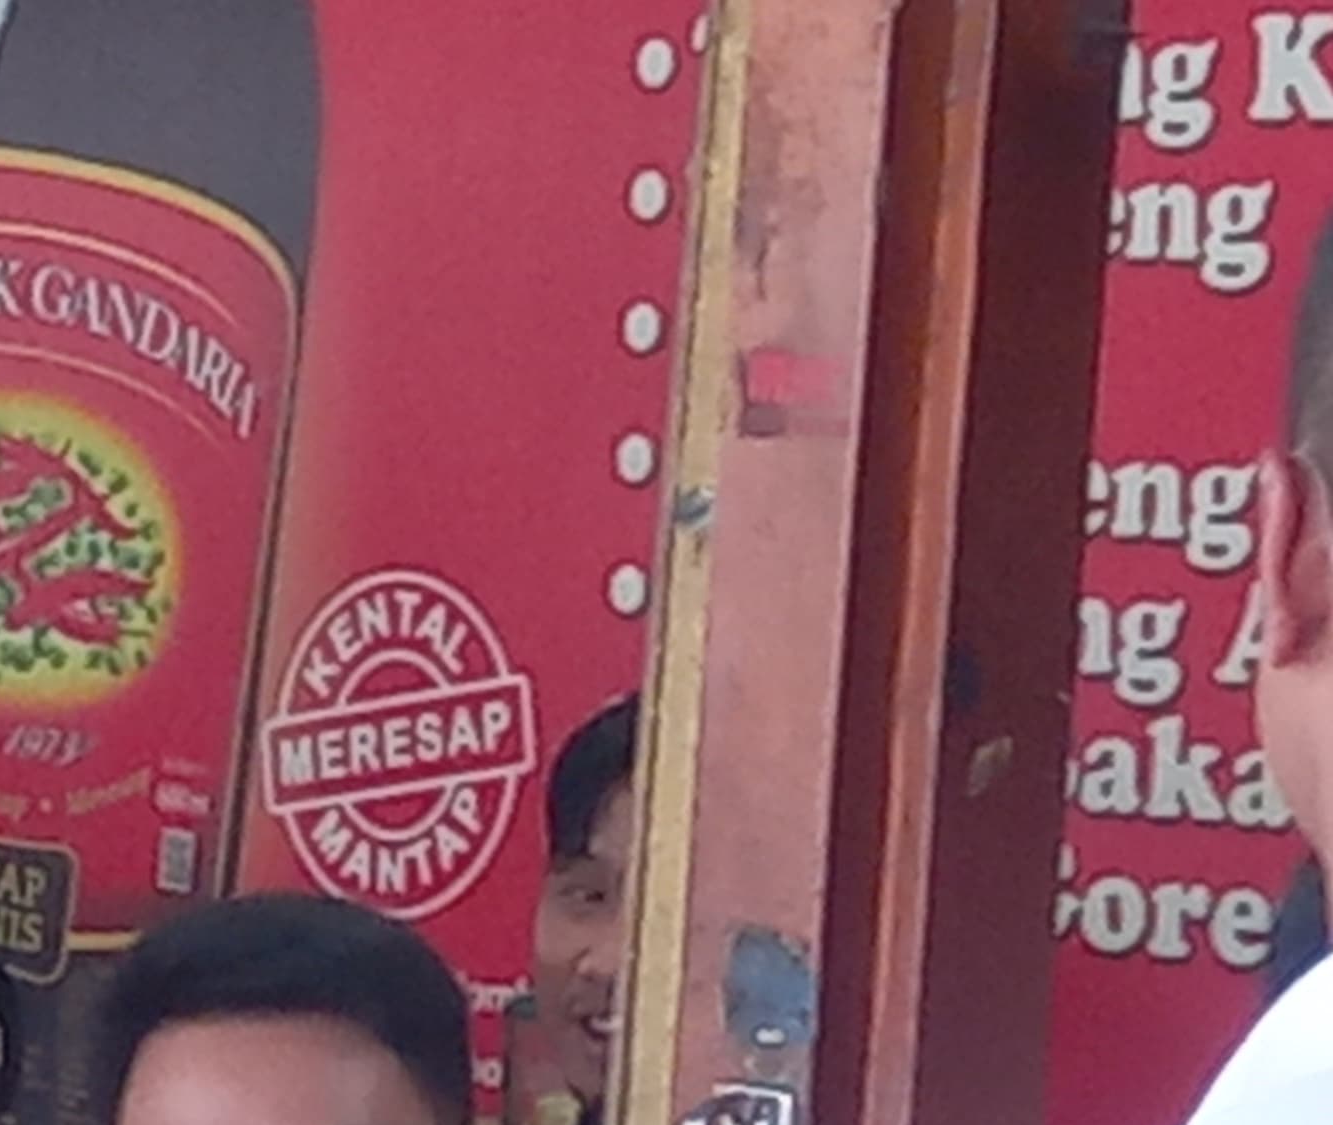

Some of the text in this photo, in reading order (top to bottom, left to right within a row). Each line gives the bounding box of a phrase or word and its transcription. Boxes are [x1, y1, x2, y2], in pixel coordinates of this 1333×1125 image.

[1107, 178, 1275, 292] ng
[31, 265, 259, 440] GANDARIA
[303, 588, 468, 697] KENTAL
[279, 700, 512, 785] MERESAP
[1065, 714, 1294, 829] aka
[310, 787, 484, 896] MANTAP
